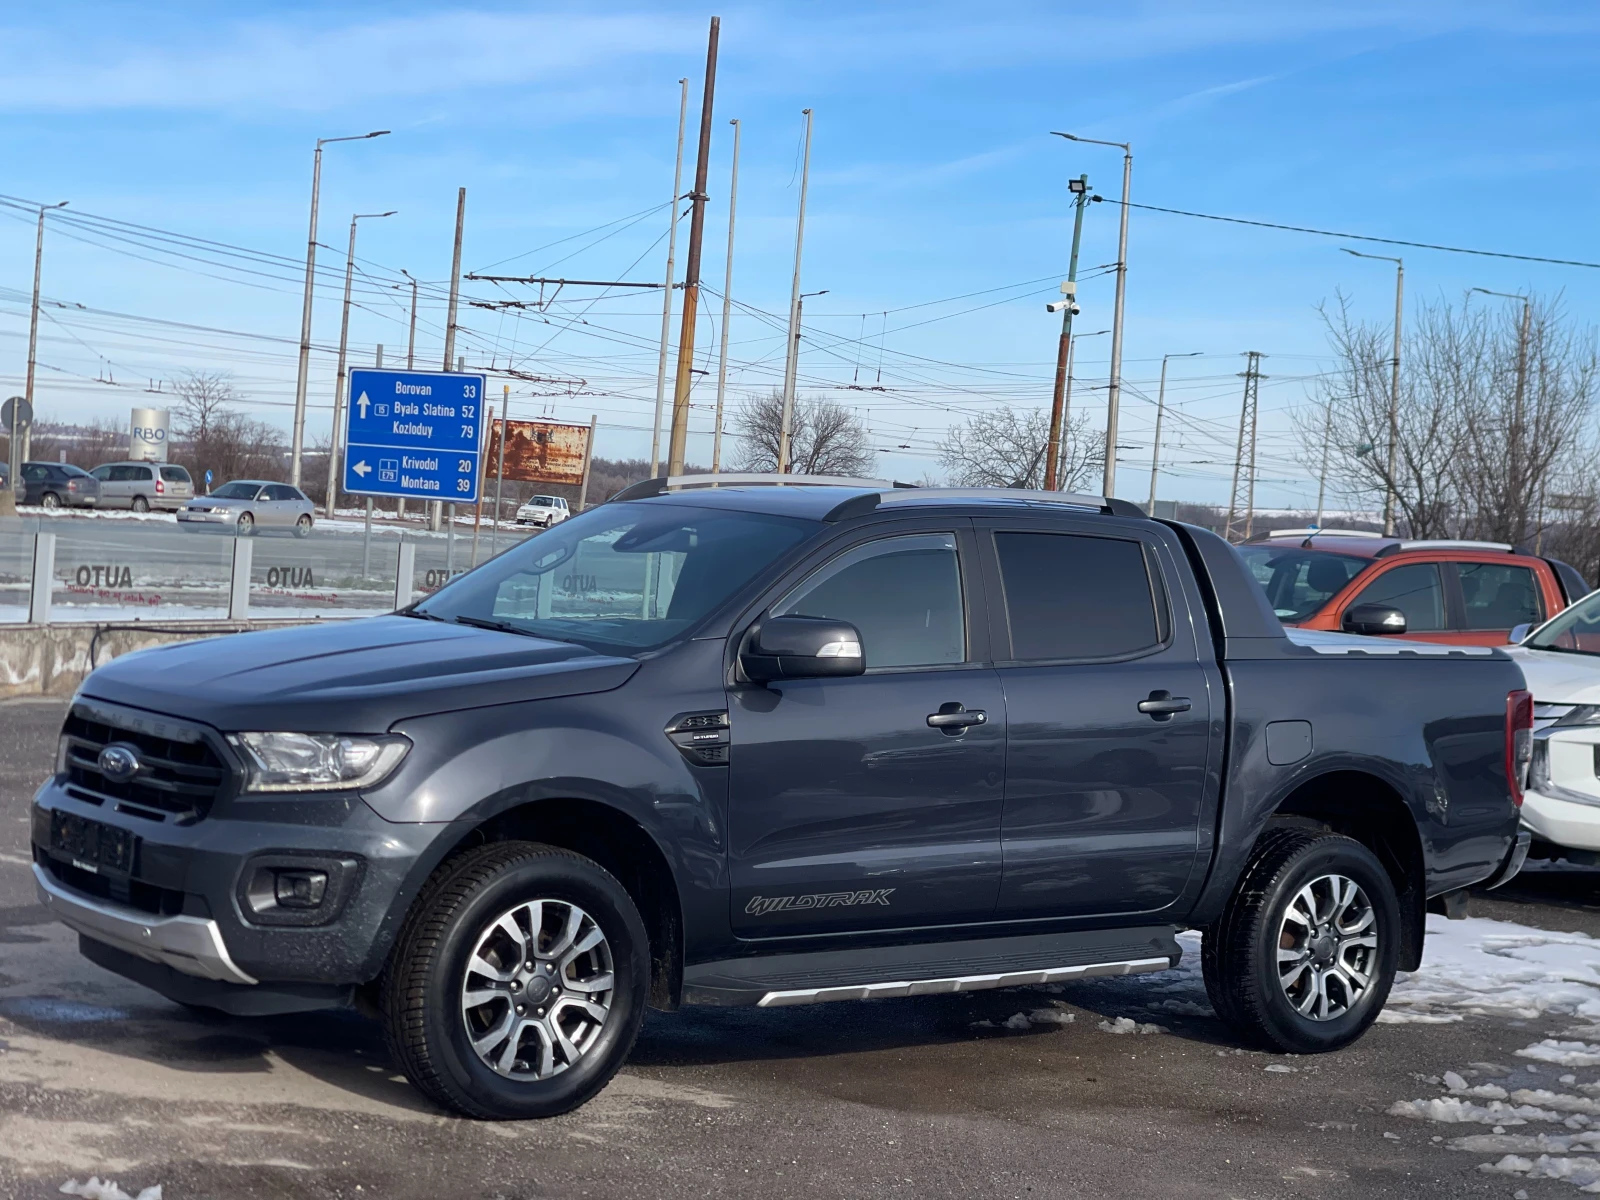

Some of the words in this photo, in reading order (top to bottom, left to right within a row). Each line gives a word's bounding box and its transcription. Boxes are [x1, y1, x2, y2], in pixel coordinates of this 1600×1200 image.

[395, 381, 432, 396] Borovan
[463, 385, 476, 398] 33
[394, 401, 419, 417] Byala
[422, 403, 455, 417] Slatina
[461, 405, 475, 418] 52
[133, 426, 165, 443] RBO
[392, 421, 433, 438] Kozloduy
[460, 425, 474, 439] 79
[402, 456, 438, 471] Krivodol
[457, 459, 472, 473] 20
[382, 471, 394, 480] E79
[401, 475, 440, 491] Montana
[456, 479, 471, 492] 39
[745, 888, 896, 916] WILDTRAK
